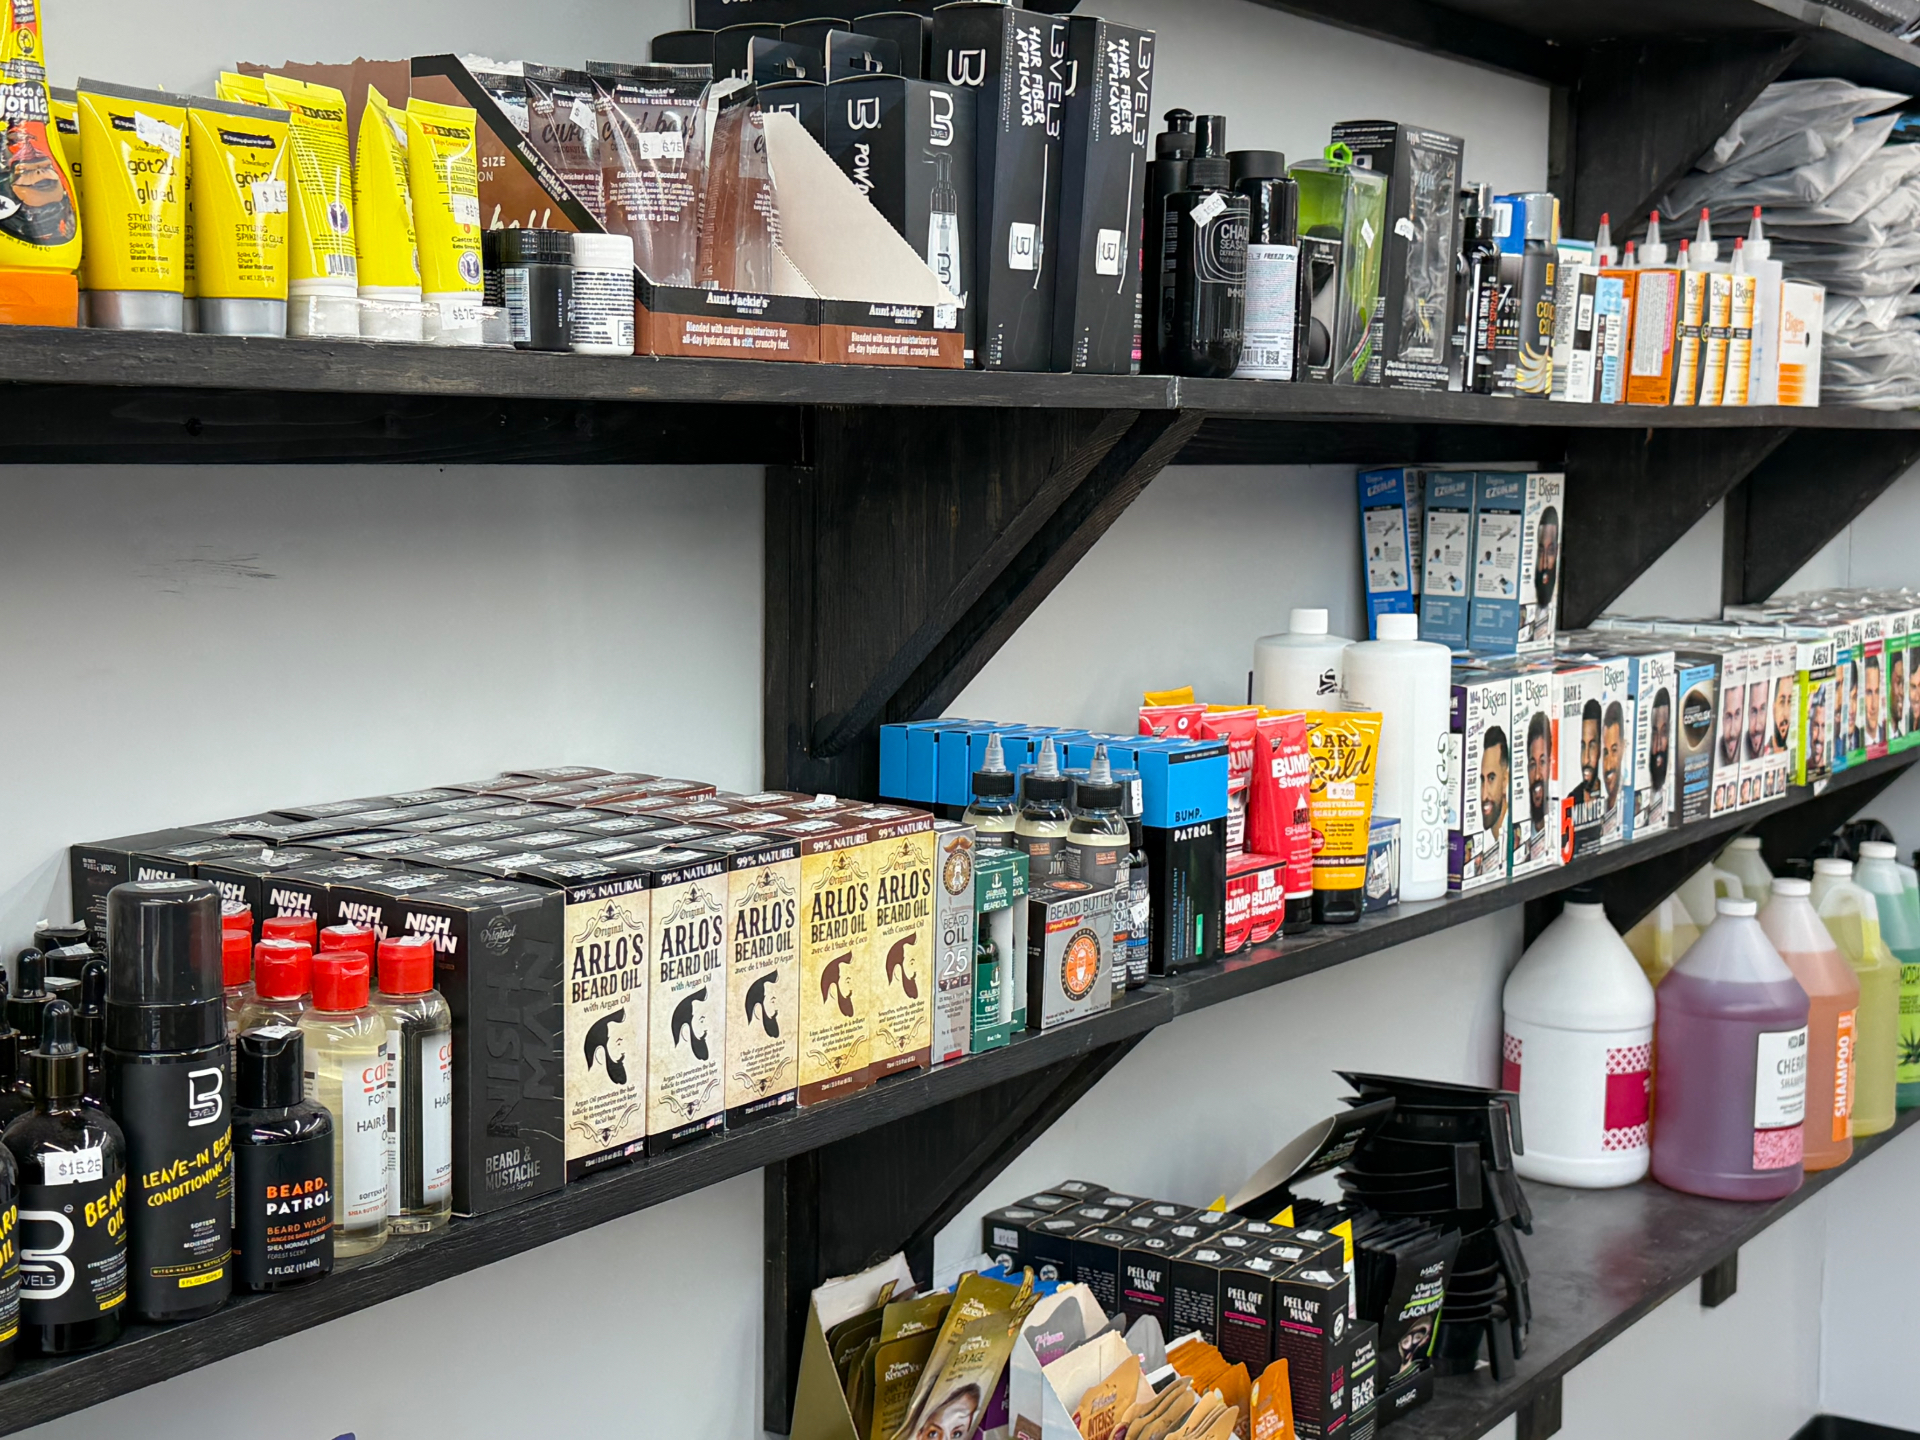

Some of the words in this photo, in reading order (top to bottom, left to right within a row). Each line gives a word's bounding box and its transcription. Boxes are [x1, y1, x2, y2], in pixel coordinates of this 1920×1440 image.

[1028, 26, 1042, 68] HAIR
[1118, 38, 1130, 79] HAIR
[1016, 28, 1033, 127] APPLICATOR
[1106, 41, 1121, 136] APPLICATOR
[1032, 74, 1046, 124] FIBER
[1121, 84, 1133, 134] FIBER
[482, 156, 506, 167] SIZE
[517, 141, 538, 166] Aunt
[537, 161, 571, 202] Jackie's
[478, 172, 493, 182] ON
[706, 291, 730, 306] Aunt
[731, 294, 769, 308] Jackie's
[869, 304, 889, 317] Aunt
[891, 306, 922, 319] Jackie's
[682, 335, 702, 347] all-day
[733, 337, 740, 347] No
[686, 321, 710, 333] Blended
[711, 323, 722, 333] with
[724, 325, 744, 336] natural
[745, 326, 778, 338] moisturizers
[779, 328, 787, 338] for
[1477, 332, 1486, 349] LINE
[1539, 476, 1560, 502] Bigen
[1604, 665, 1625, 692] Bigen
[1482, 688, 1507, 716] Bigen
[1525, 679, 1549, 707] Bigen
[812, 840, 832, 853] 99%
[833, 832, 868, 849] NATUREL
[878, 826, 896, 840] 99%
[897, 819, 931, 836] NATURAL
[1174, 823, 1213, 843] PATROL
[1560, 796, 1575, 865] 5
[736, 855, 756, 869] 99%
[758, 847, 795, 865] NATUREL
[660, 870, 681, 885] 99%
[683, 861, 723, 881] NATURAL
[573, 887, 597, 902] 99%
[598, 878, 643, 898] NATURAL
[876, 868, 931, 907] ARLO'S
[1251, 885, 1284, 911] BUMP
[810, 882, 869, 923] ARLO'S
[877, 900, 912, 927] BEARD
[914, 898, 930, 918] OIL
[1050, 900, 1080, 920] BEARD
[1083, 892, 1113, 912] BUTTER
[734, 899, 796, 941] ARLO'S
[811, 918, 848, 944] BEARD
[851, 914, 867, 935] OIL
[882, 927, 894, 936] with
[895, 922, 916, 934] Coconut
[917, 920, 925, 929] Oil
[943, 914, 968, 930] BEARD
[659, 914, 723, 961] ARLO'S
[735, 935, 774, 963] BEARD
[776, 930, 794, 953] OIL
[944, 930, 968, 946] OIL
[571, 933, 643, 980] ARLO'S
[660, 953, 701, 983] BEARD
[703, 948, 722, 972] OIL
[943, 947, 968, 977] 25
[572, 973, 617, 1004] BEARD
[621, 968, 642, 992] OIL
[583, 1003, 599, 1013] with
[600, 997, 619, 1010] Argan
[620, 993, 631, 1004] Oil
[1834, 1036, 1850, 1117] SHAMPOO
[357, 1116, 381, 1133] HAIR
[143, 1148, 209, 1189] LEAVE-IN
[485, 1148, 521, 1174] BEARD
[524, 1146, 531, 1161] &
[147, 1161, 223, 1207] CONDITIONING
[266, 1177, 328, 1199] BEARD.
[485, 1159, 541, 1192] MUSTACHE
[107, 1207, 125, 1237] OIL
[267, 1223, 301, 1236] BEARD
[303, 1216, 326, 1229] WASH
[267, 1267, 273, 1275] 4
[1127, 1265, 1145, 1278] PEEL
[1146, 1268, 1162, 1281] OFF
[1227, 1286, 1246, 1300] PEEL
[1248, 1291, 1264, 1305] OFF
[1234, 1300, 1257, 1314] MASK
[1283, 1295, 1303, 1309] PEEL
[1304, 1300, 1321, 1314] OFF
[1290, 1309, 1313, 1323] MASK
[1351, 1375, 1375, 1399] BLACK
